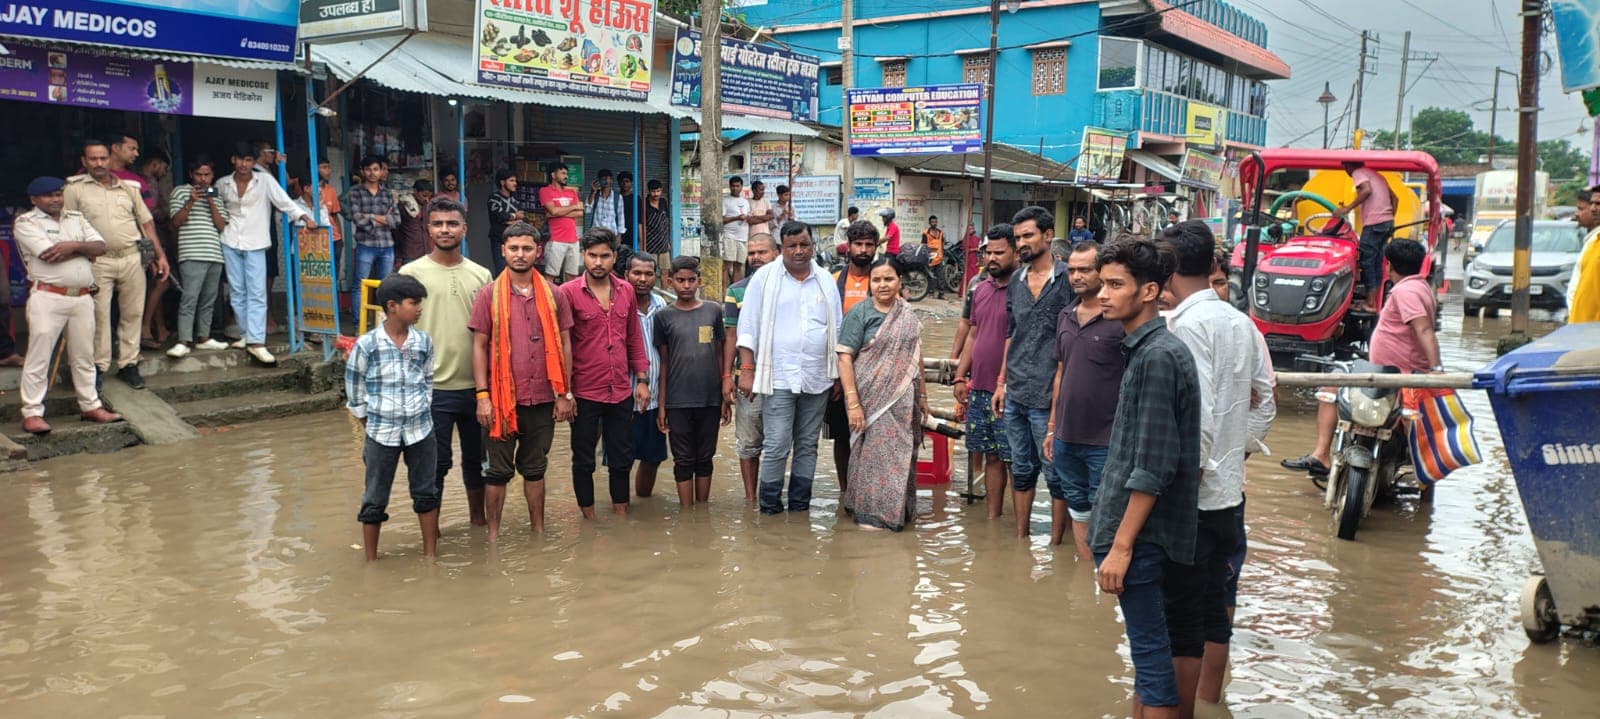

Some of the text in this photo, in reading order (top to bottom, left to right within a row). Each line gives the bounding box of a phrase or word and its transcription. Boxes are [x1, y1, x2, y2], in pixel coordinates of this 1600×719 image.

[319, 1, 360, 18] उपलब्ध
[0, 4, 157, 38] JAY MEDICOS
[205, 76, 270, 90] AJAY MEDICOSE
[850, 93, 885, 104] SATYAM
[885, 91, 930, 103] COMPUTER
[931, 89, 979, 101] EDUCATION
